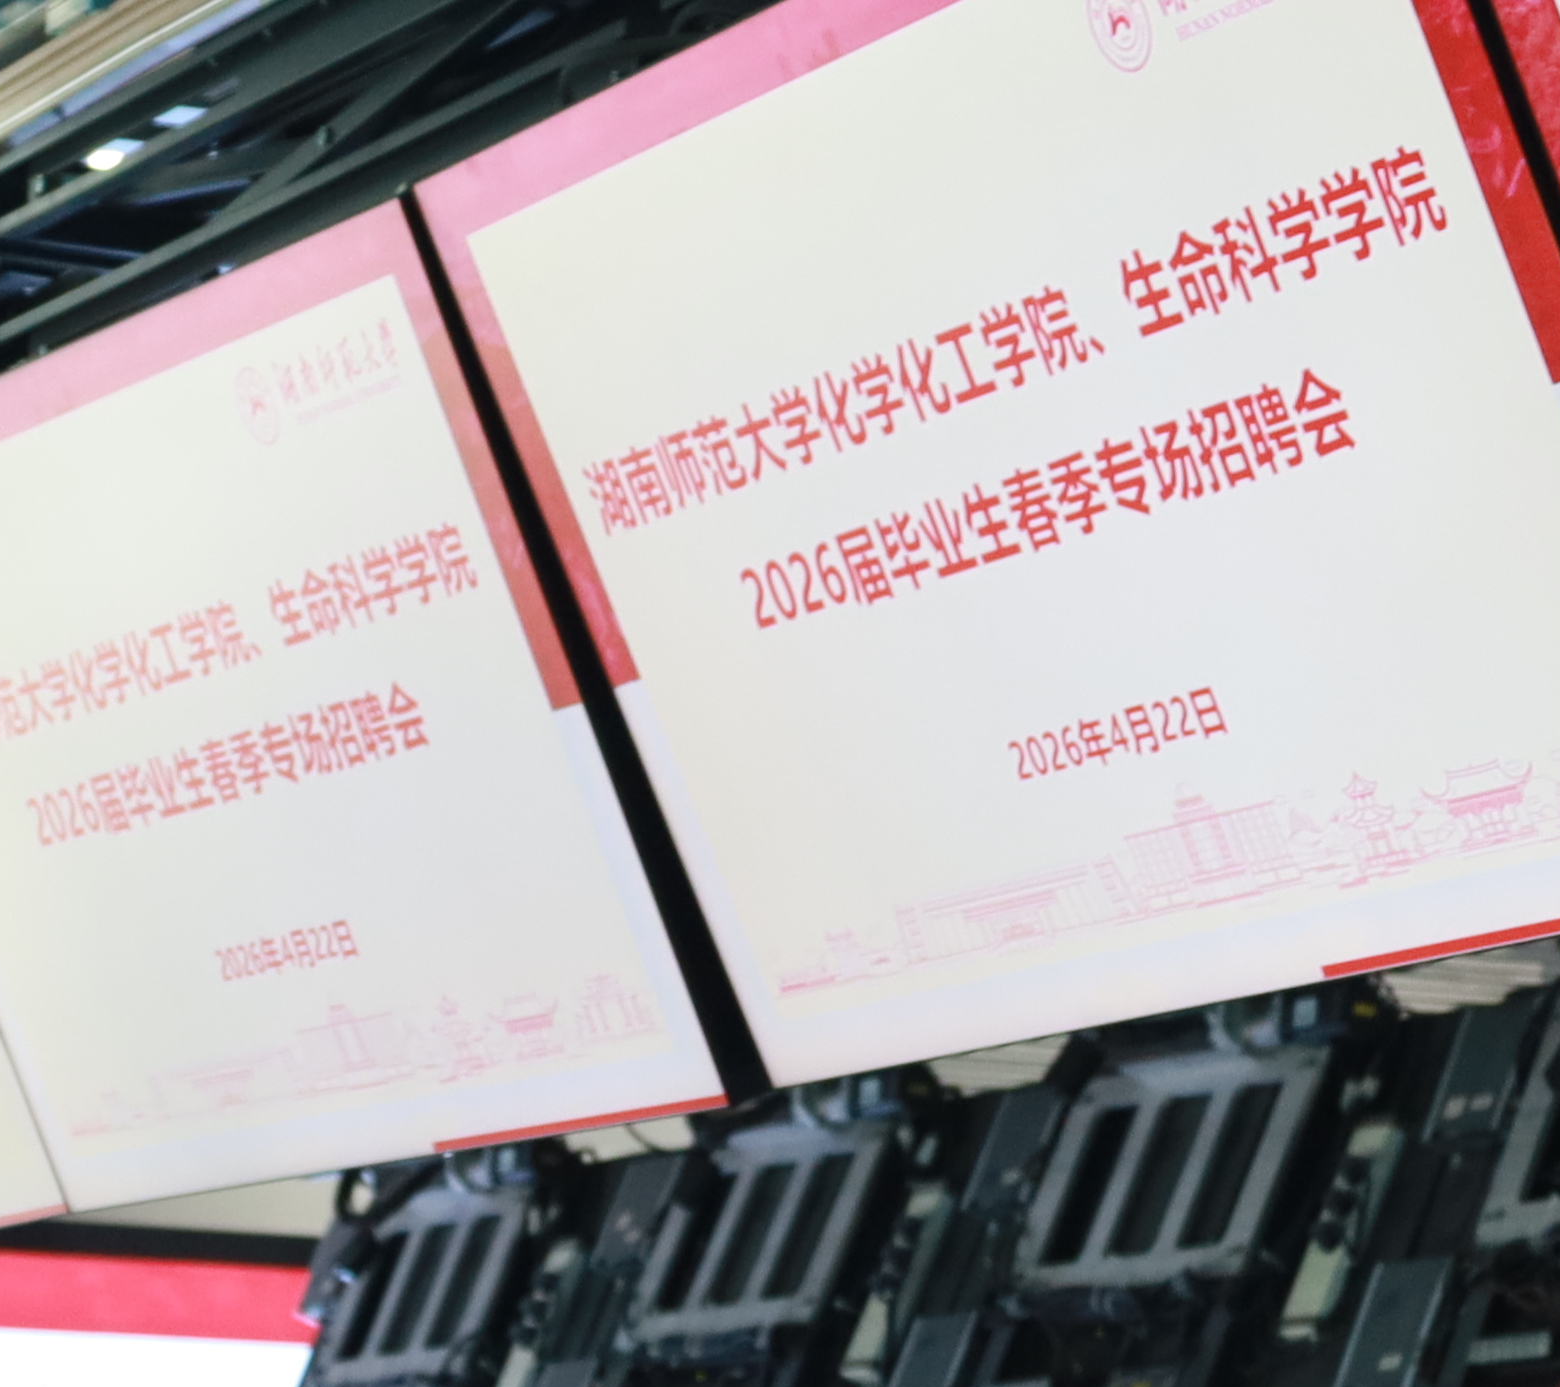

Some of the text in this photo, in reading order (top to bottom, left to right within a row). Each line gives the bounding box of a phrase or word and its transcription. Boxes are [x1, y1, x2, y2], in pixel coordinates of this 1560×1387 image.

[583, 146, 1449, 535] 湖南师范大学化学化工学院、生命科学学院
[739, 366, 1358, 630] 2026届毕业生春季专场招聘会
[27, 681, 430, 847] 2026届毕业生春季专场招聘会
[1008, 686, 1228, 780] 2026年4月22日
[215, 919, 360, 983] 2026年4月22日
